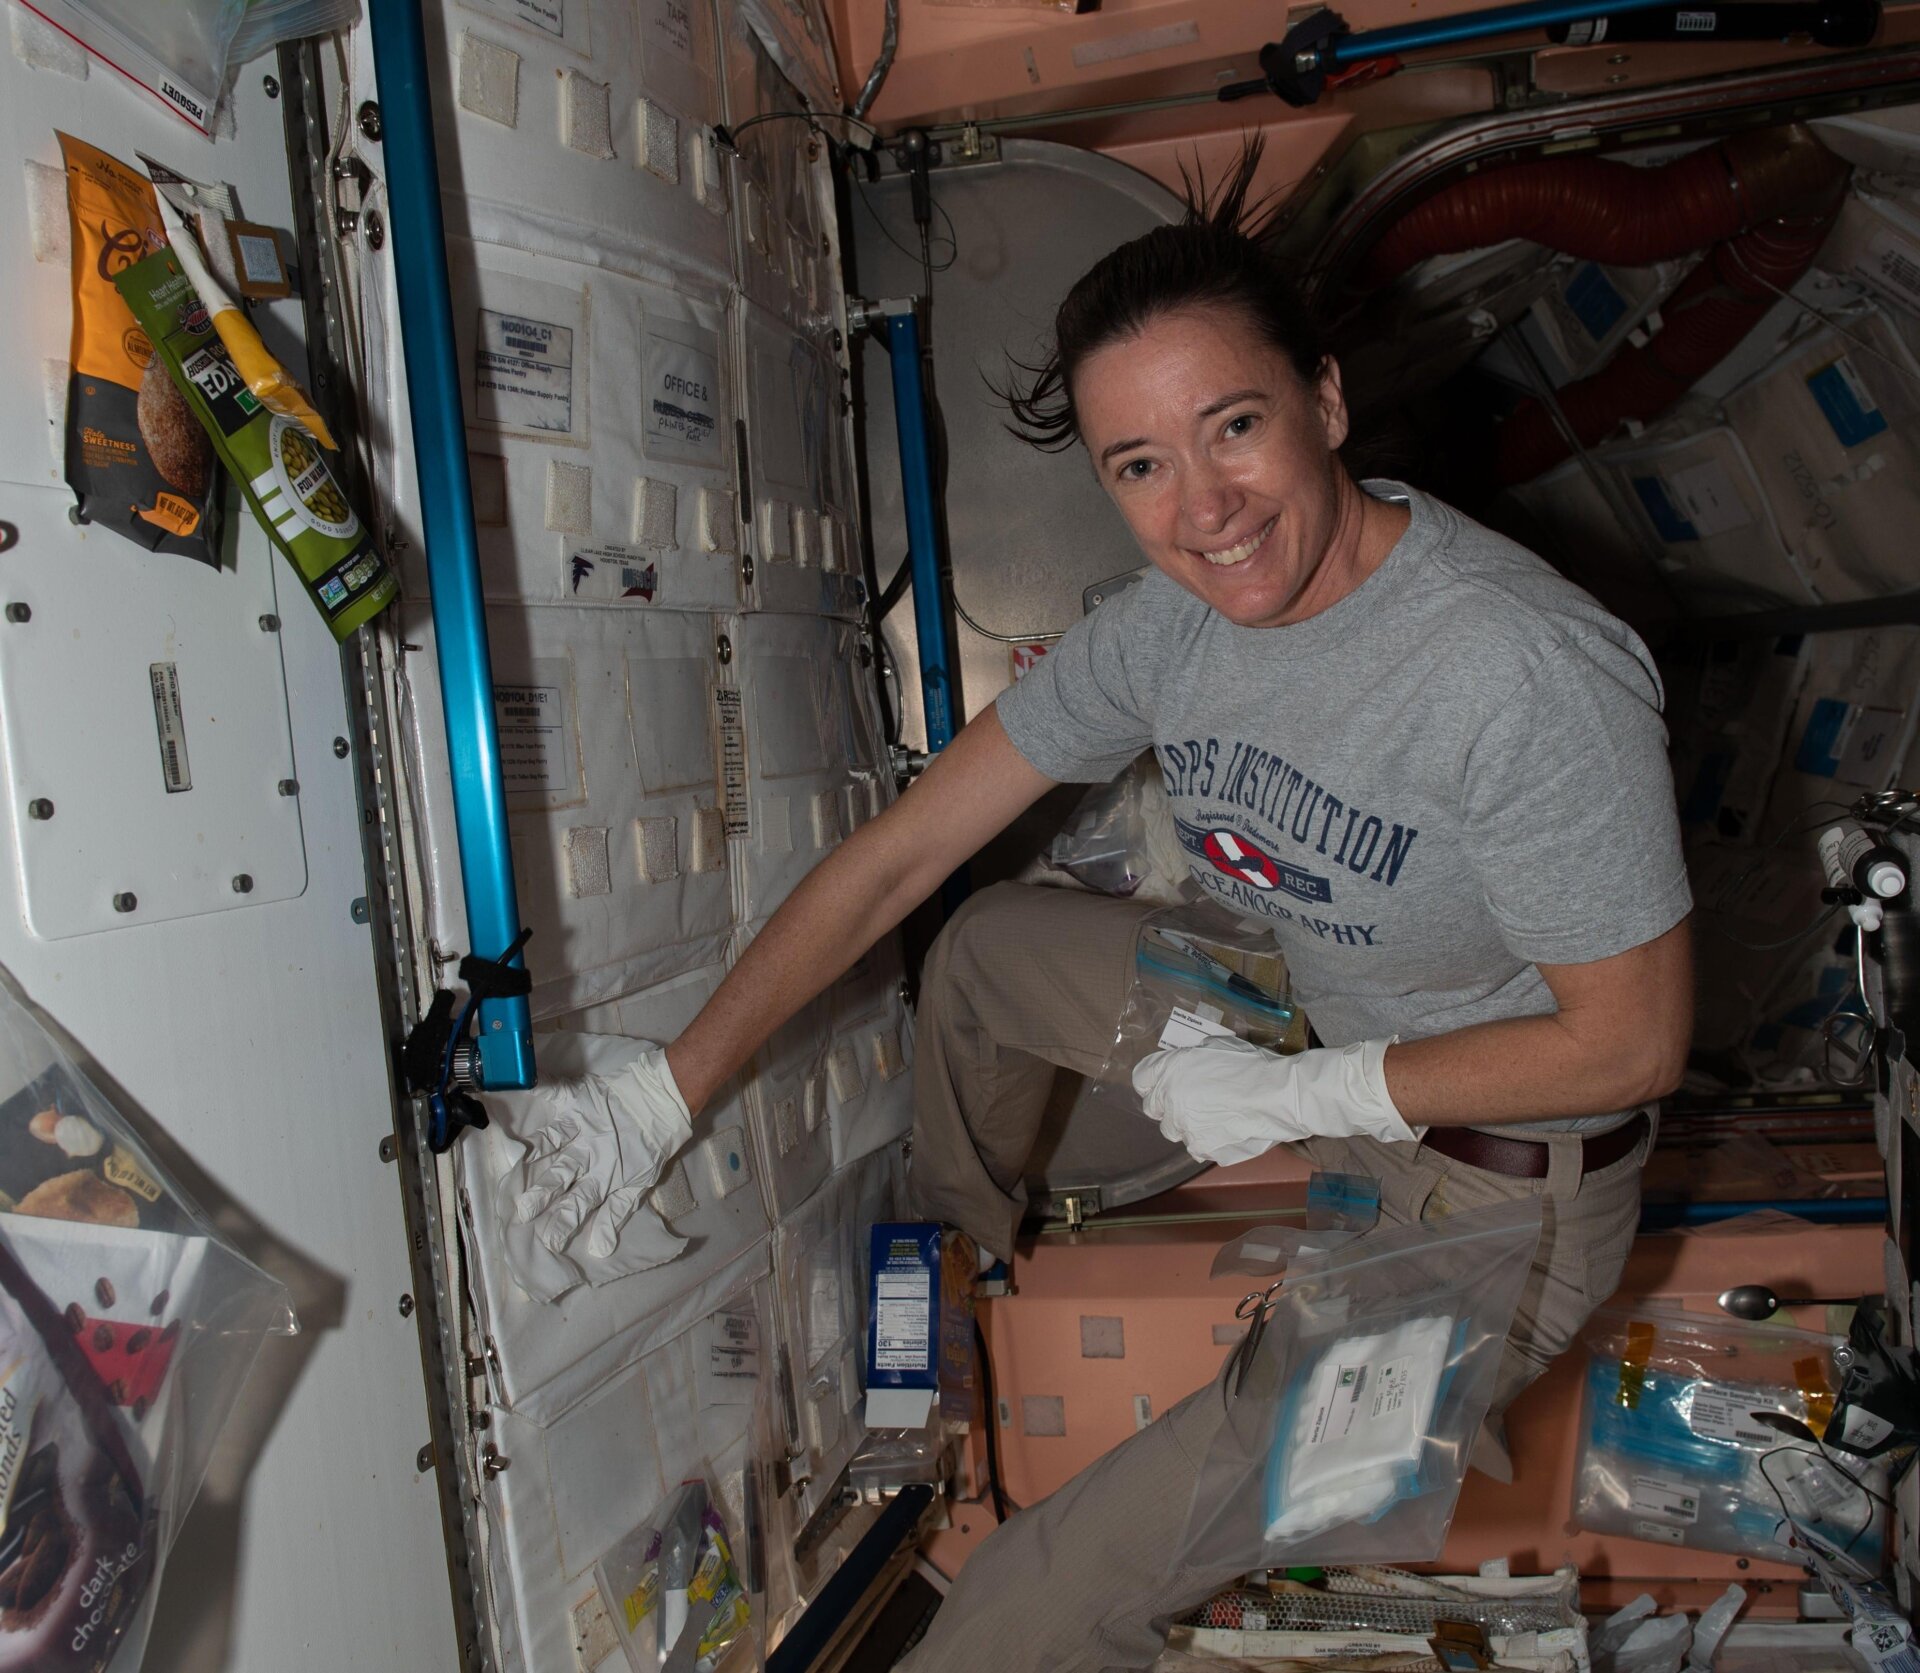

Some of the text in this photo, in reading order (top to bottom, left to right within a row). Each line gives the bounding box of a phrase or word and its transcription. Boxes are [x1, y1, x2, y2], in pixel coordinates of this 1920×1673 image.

[161, 82, 204, 121] PESQUET
[201, 353, 241, 400] EDA
[664, 373, 708, 401] OFFICE &
[83, 436, 137, 453] SWEETNESS
[297, 477, 314, 495] FOD
[310, 517, 333, 533] GOOD
[170, 689, 180, 717] Marker
[1217, 740, 1419, 888] INSTITUTION
[1195, 808, 1235, 824] Registered
[1243, 818, 1281, 854] Trademark
[1283, 871, 1324, 899] REC.
[877, 1339, 891, 1347] 130
[902, 1339, 926, 1347] Calories
[1729, 1389, 1762, 1404] Sampling
[1763, 1395, 1774, 1406] Kit
[71, 1541, 138, 1653] chocolate
[79, 1555, 114, 1611] dark
